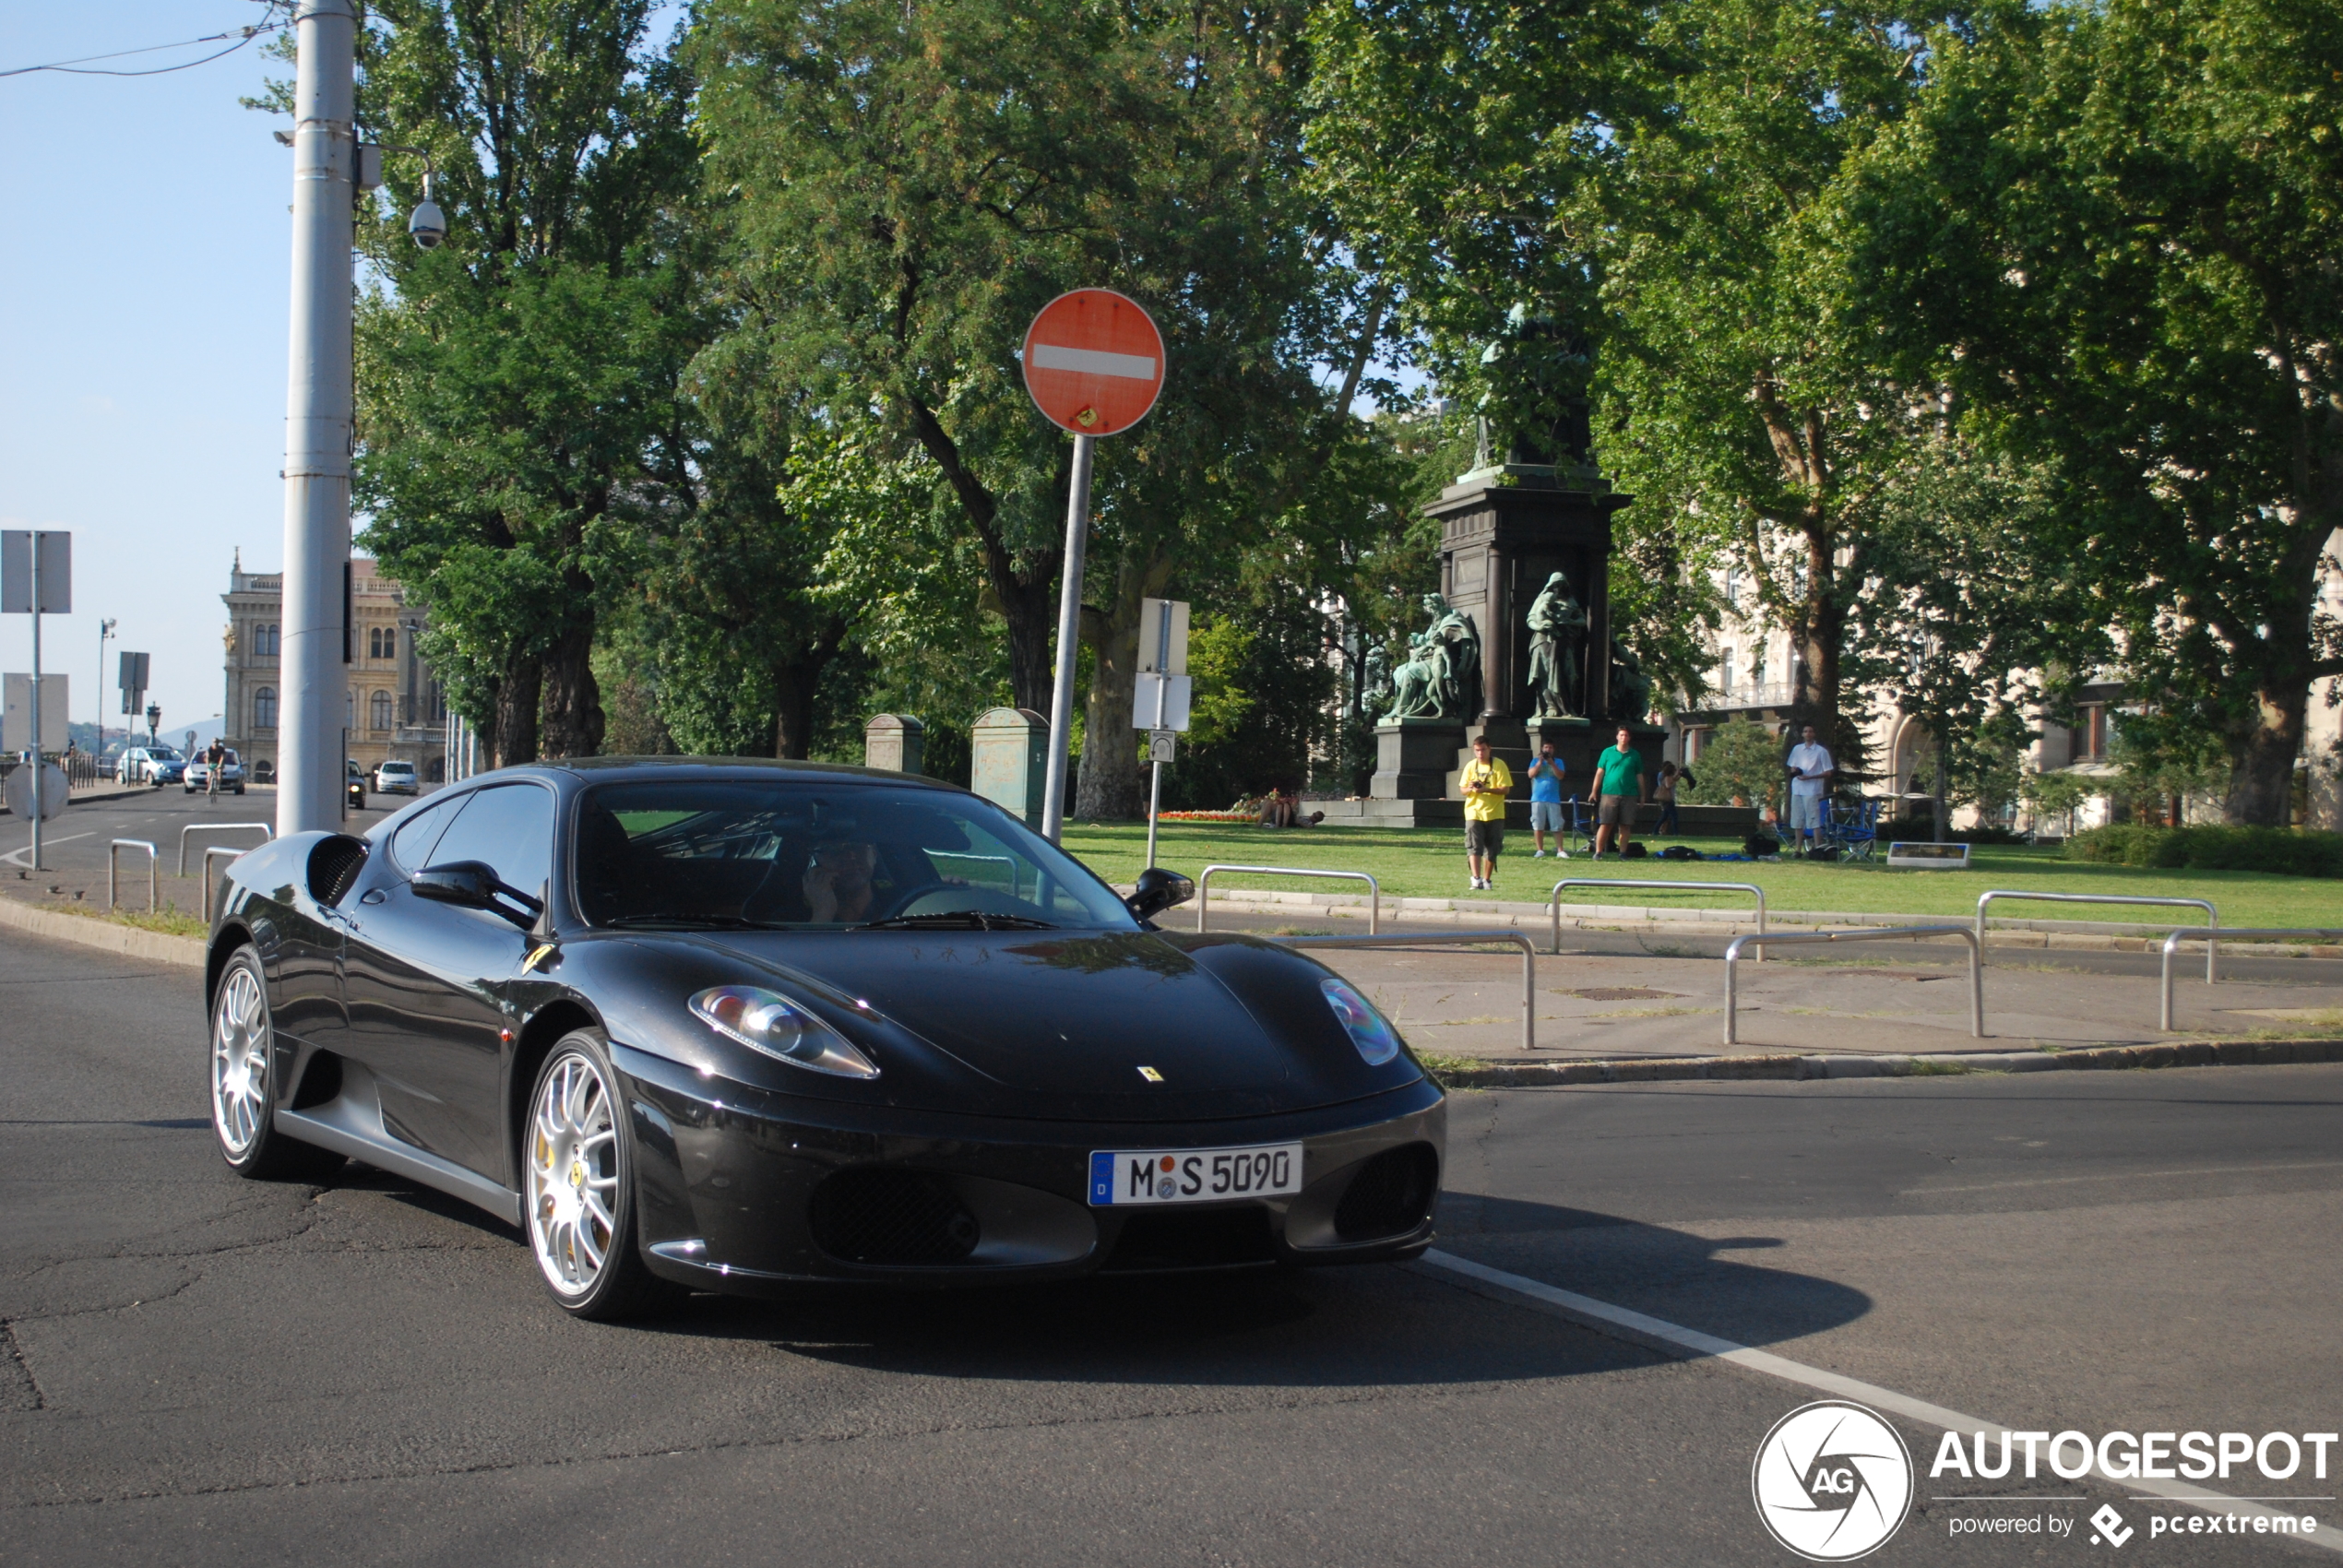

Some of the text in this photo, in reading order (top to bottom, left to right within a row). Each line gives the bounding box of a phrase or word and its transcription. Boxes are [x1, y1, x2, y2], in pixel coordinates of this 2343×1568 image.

[1130, 1150, 1290, 1196] M S 5090
[1097, 1183, 1106, 1195] D
